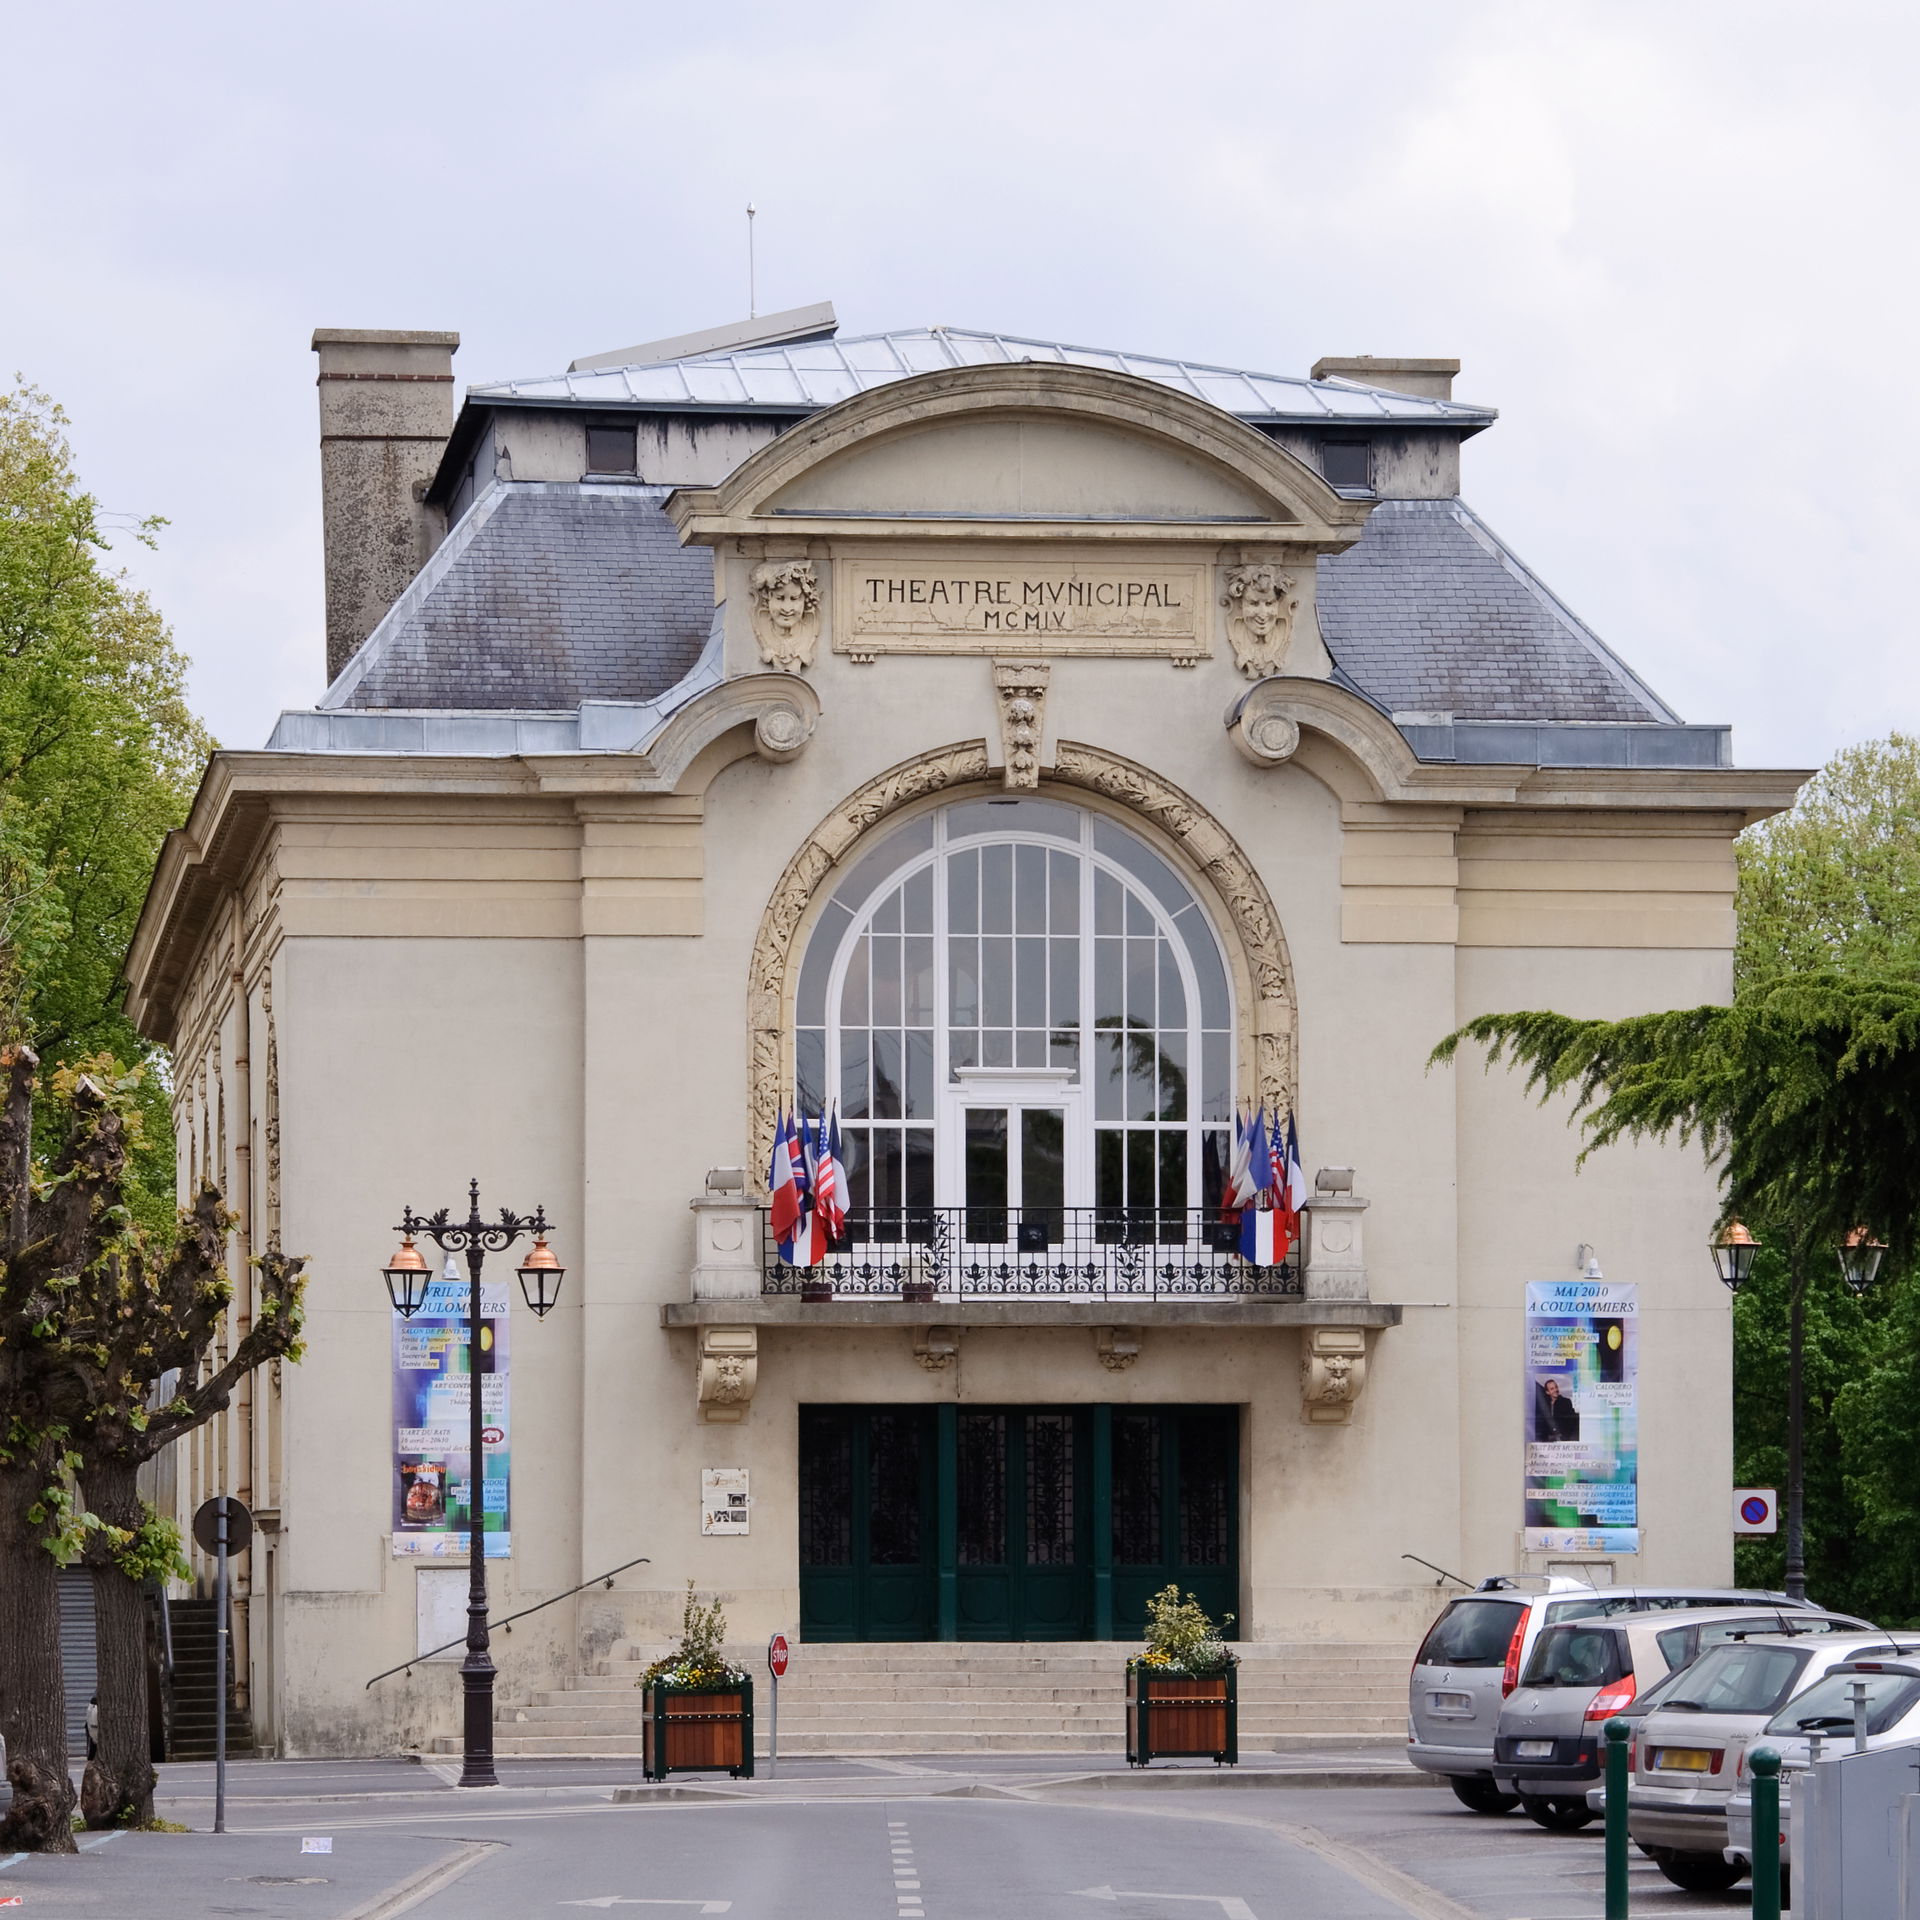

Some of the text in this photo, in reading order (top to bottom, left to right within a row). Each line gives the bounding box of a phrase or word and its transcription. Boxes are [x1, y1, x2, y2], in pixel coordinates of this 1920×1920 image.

[866, 579, 1181, 607] THEATRE MVNICIPAL
[984, 611, 1066, 629] MCMIV
[424, 1287, 485, 1297] VRIL 200
[1555, 1287, 1608, 1297] MAI 2010
[1528, 1302, 1634, 1313] A COULOMMIERS
[773, 1649, 787, 1663] STOP
